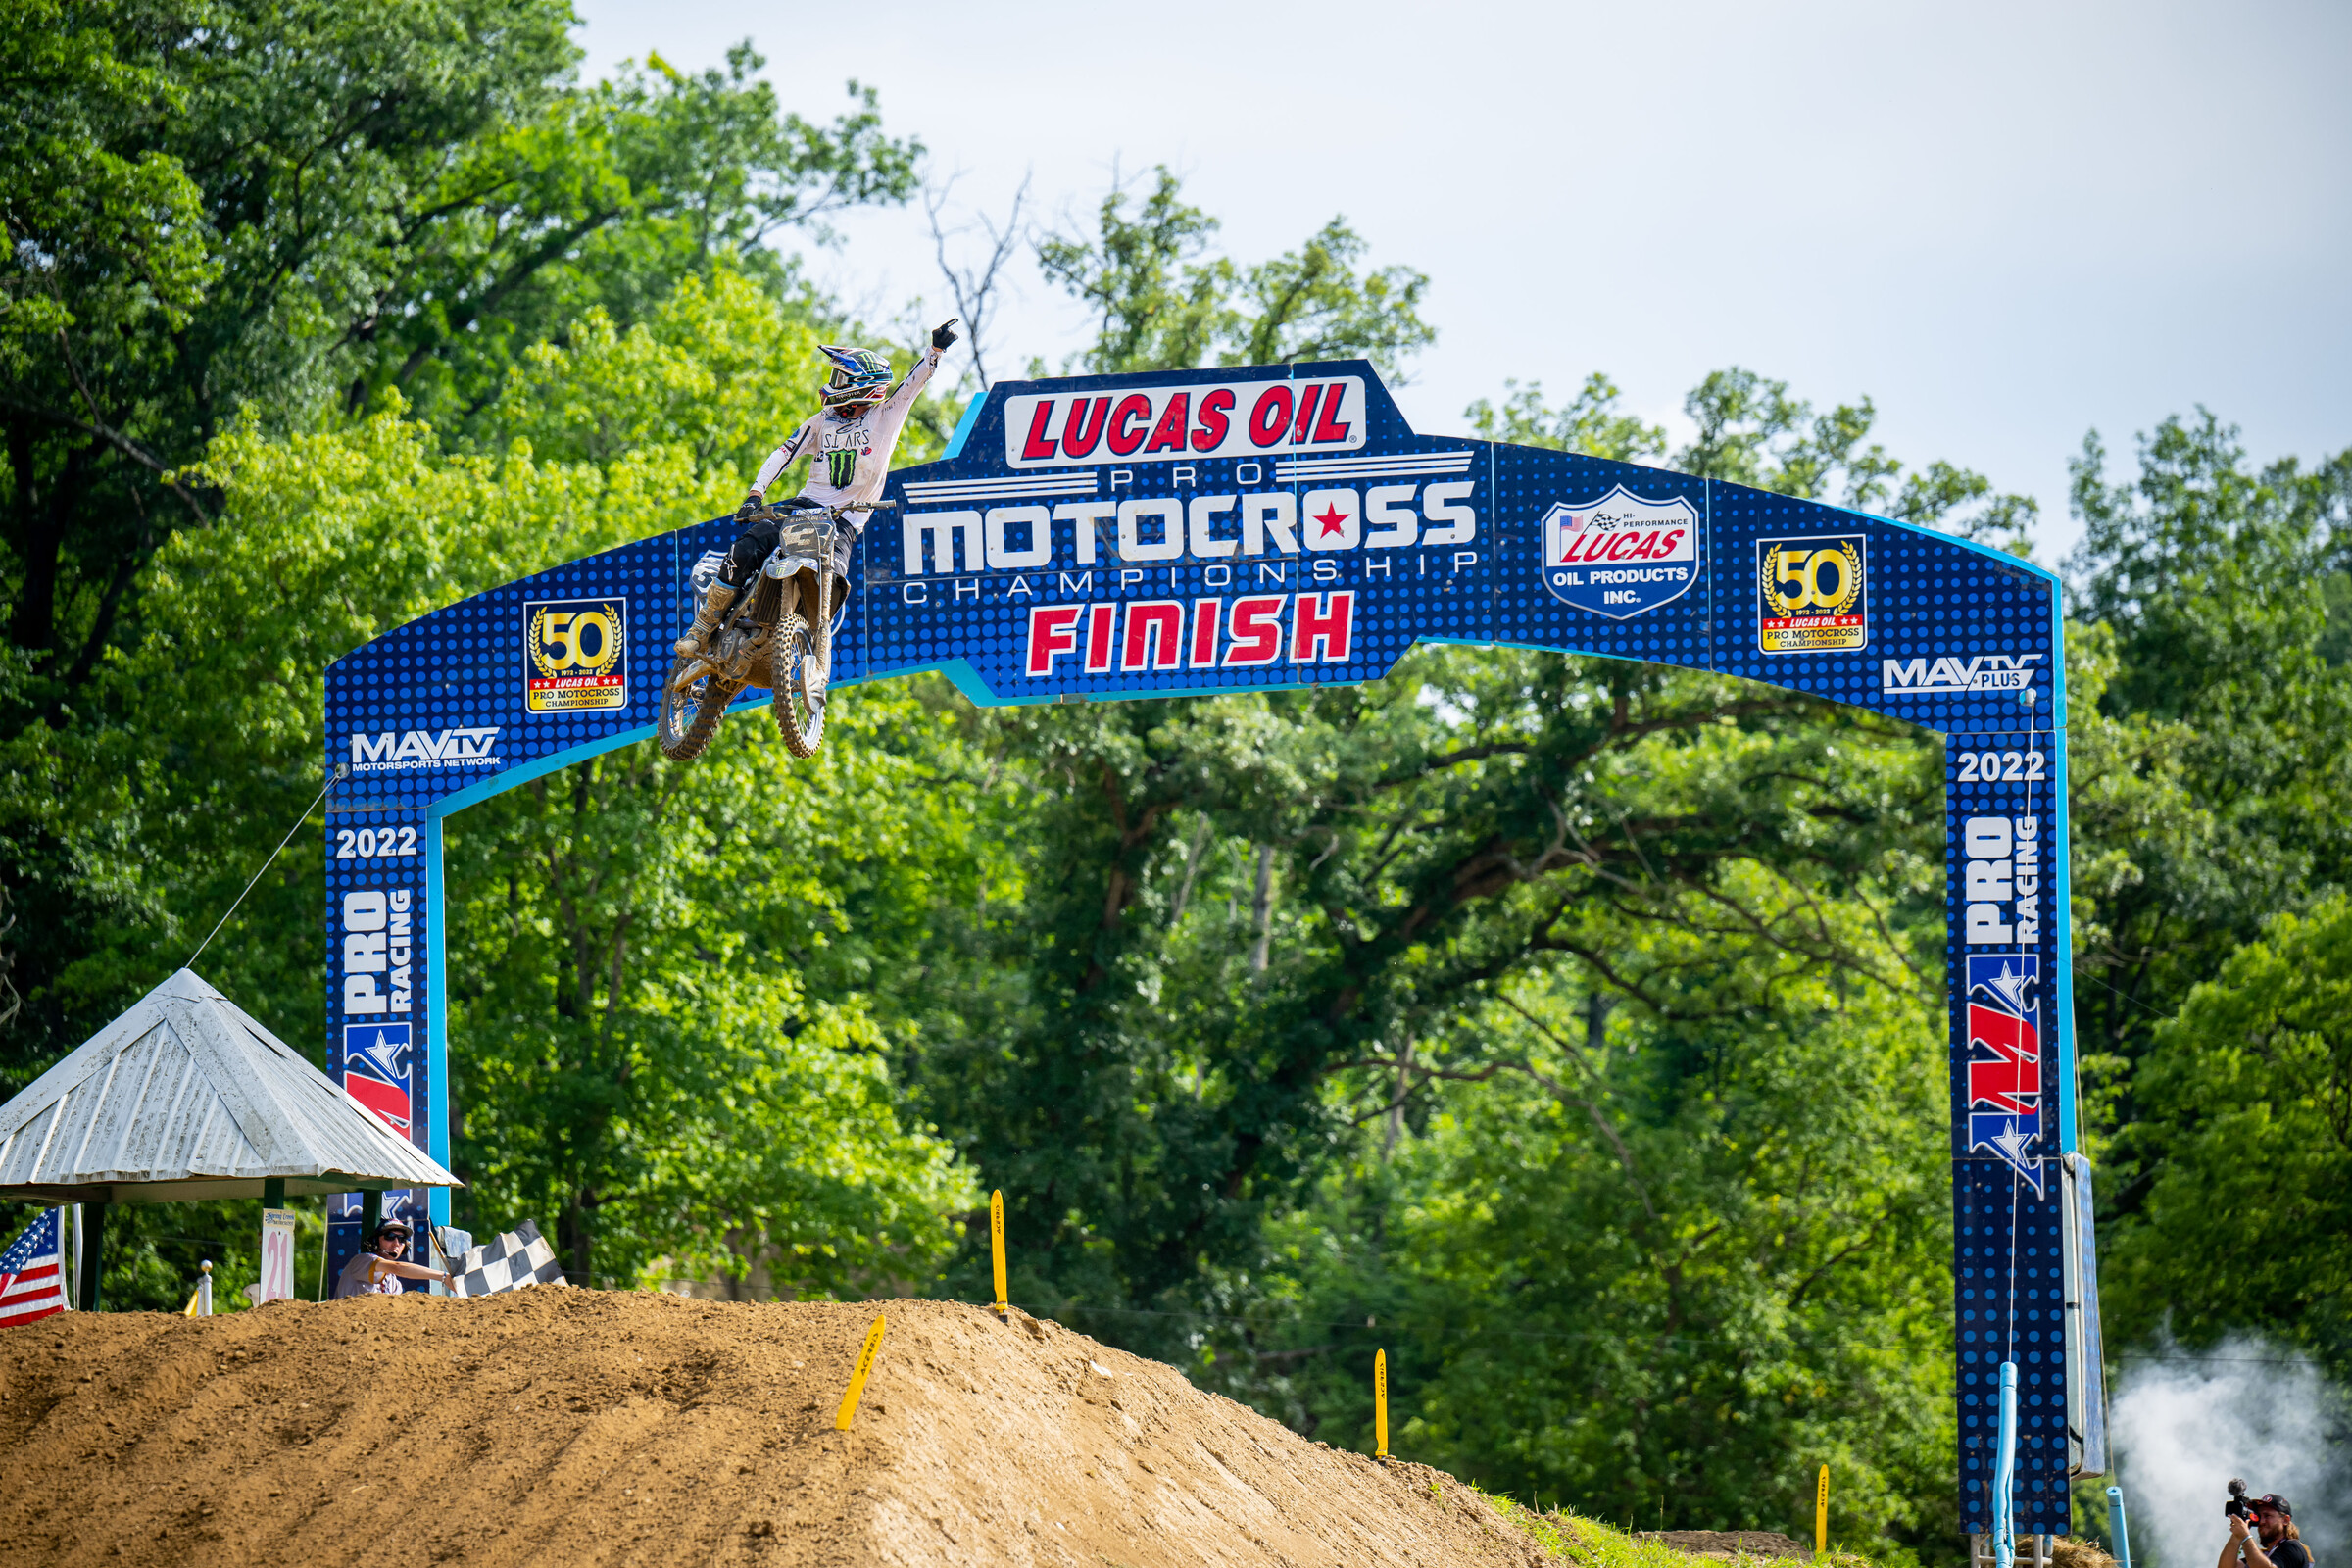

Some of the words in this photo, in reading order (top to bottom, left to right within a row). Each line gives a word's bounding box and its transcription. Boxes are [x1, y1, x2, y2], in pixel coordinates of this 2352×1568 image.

[1021, 389, 1235, 461] LUCAS
[1249, 382, 1352, 448] OIL
[1111, 463, 1261, 492] PRO
[903, 481, 1475, 575] MOTOCROSS
[1623, 518, 1689, 528] PERFORMANCE
[1560, 529, 1686, 563] LUCAS
[903, 551, 1478, 605] CHAMPIONSHIP
[1552, 572, 1584, 586] OIL
[1590, 567, 1689, 585] PRODUCTS
[1774, 549, 1853, 610] 50
[1026, 590, 1355, 677] FINISH
[1767, 630, 1788, 640] PRO
[1792, 627, 1859, 639] MOTOCROSS
[1789, 617, 1819, 628] LUCAS
[1821, 617, 1837, 626] OIL
[541, 612, 614, 670] 50
[1780, 638, 1847, 647] CHAMPIONSHIP
[555, 678, 583, 688] LUCAS
[584, 677, 598, 687] OIL
[1883, 654, 2043, 688] MAVTV
[1982, 672, 2021, 688] PLUS
[533, 691, 555, 700] PRO
[558, 688, 620, 699] MOTOCROSS
[546, 698, 609, 707] CHAMPIONSHIP
[352, 727, 501, 763] MAVTV
[353, 760, 441, 771] MOTORSPORTS
[444, 757, 501, 767] NETWORK
[1958, 751, 2045, 782] 2022
[336, 827, 417, 858] 2022
[1965, 815, 2013, 945] PRO
[2016, 815, 2039, 944] RACING
[343, 891, 387, 1015] PRO
[390, 889, 412, 1013] RACING
[860, 1332, 879, 1377] ACERBIS
